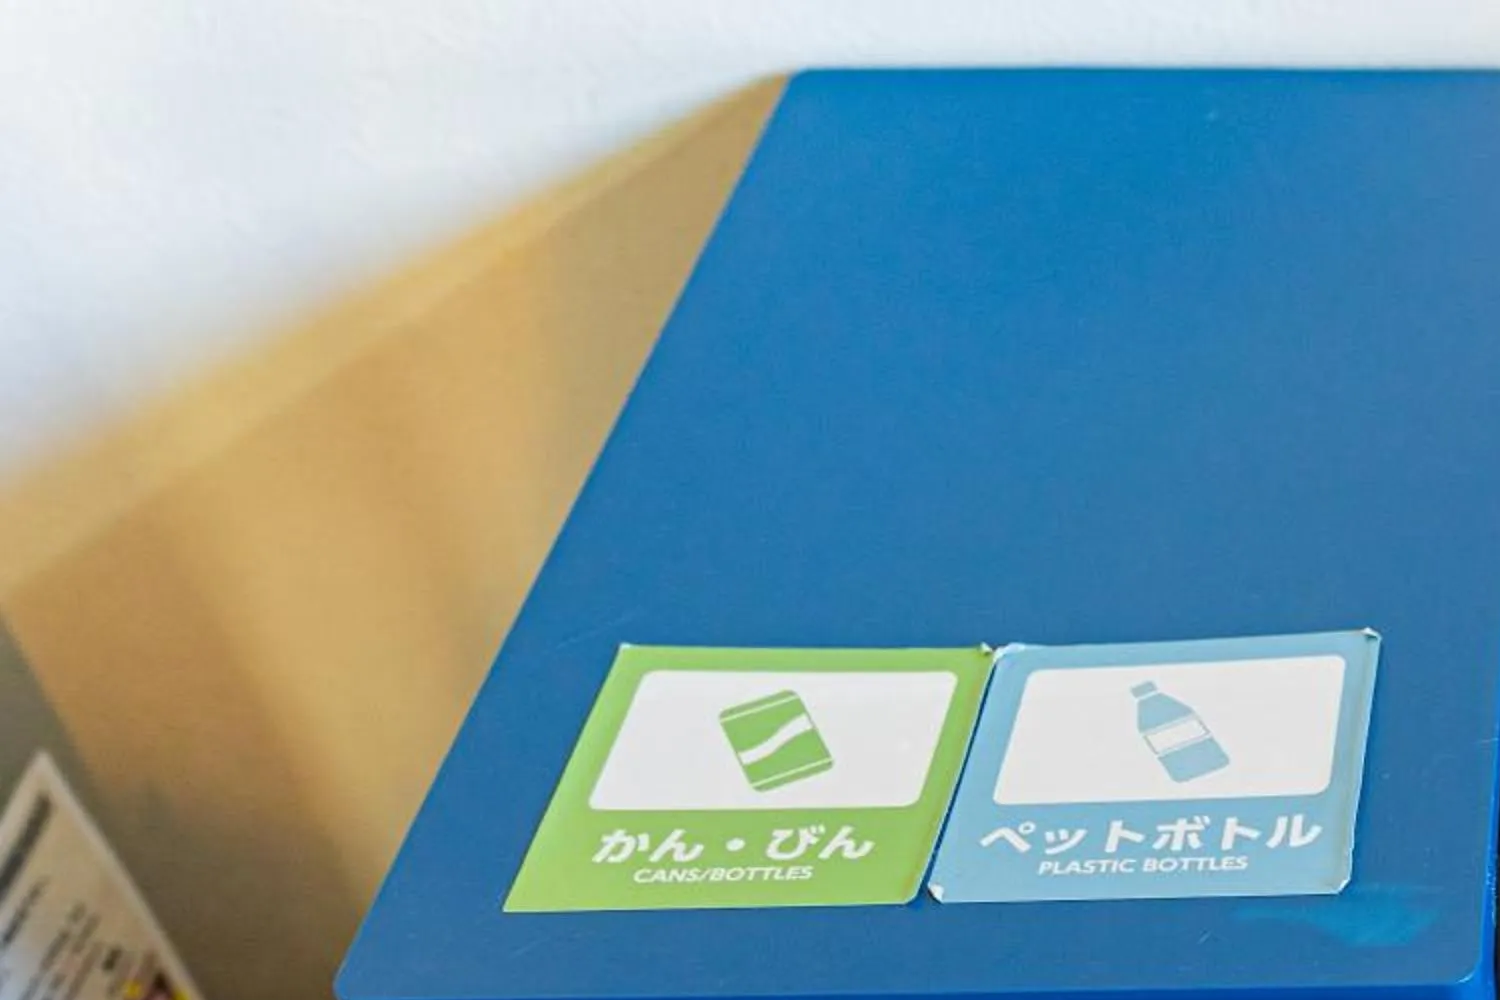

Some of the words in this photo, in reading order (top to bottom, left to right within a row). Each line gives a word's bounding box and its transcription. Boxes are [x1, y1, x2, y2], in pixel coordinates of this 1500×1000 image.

[592, 824, 875, 863] かん・びん
[980, 814, 1323, 855] ペットボトル
[633, 865, 814, 883] CANS/BOTTLES
[1037, 858, 1137, 876] PLASTIC
[1142, 855, 1249, 873] BOTTLES
